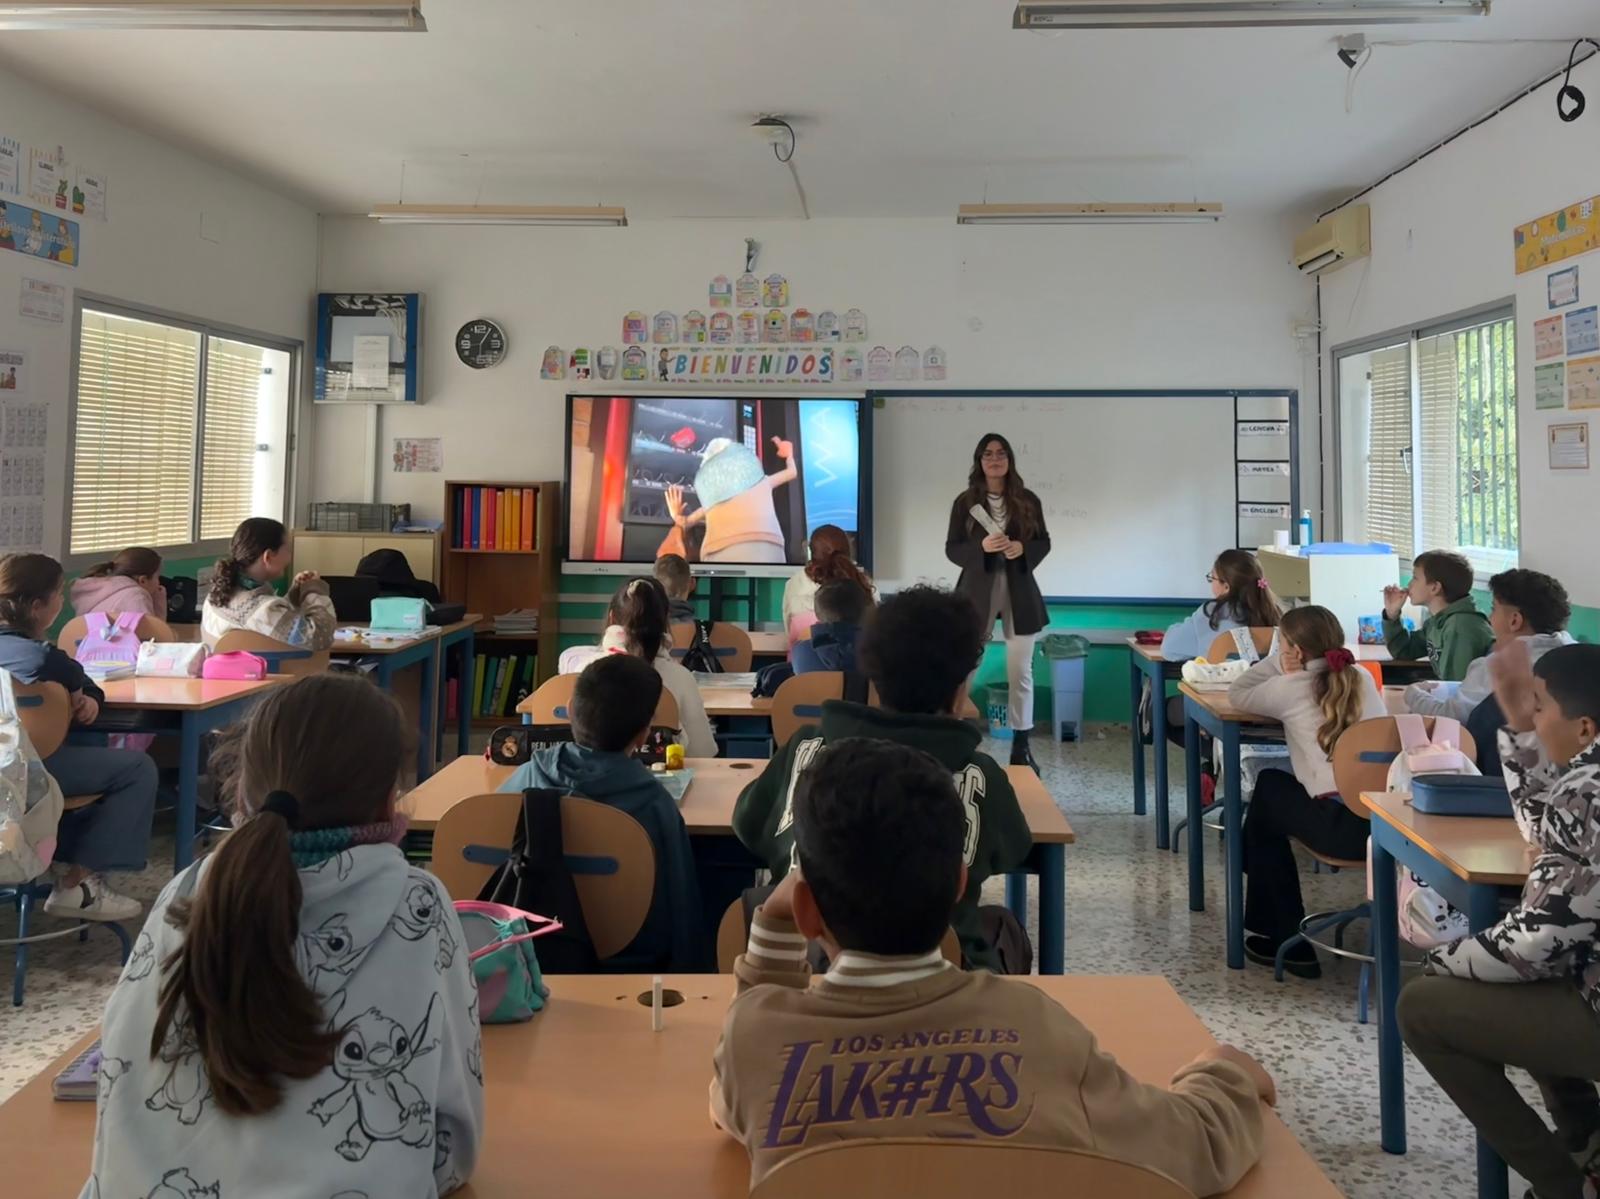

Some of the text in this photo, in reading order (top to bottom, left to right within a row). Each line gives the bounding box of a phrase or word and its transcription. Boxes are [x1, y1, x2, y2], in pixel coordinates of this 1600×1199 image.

[474, 325, 486, 334] 12
[461, 340, 471, 349] 9
[491, 339, 500, 348] 3
[675, 353, 831, 375] BIENVENIDOS
[831, 1028, 1019, 1056] LOS ANGELES
